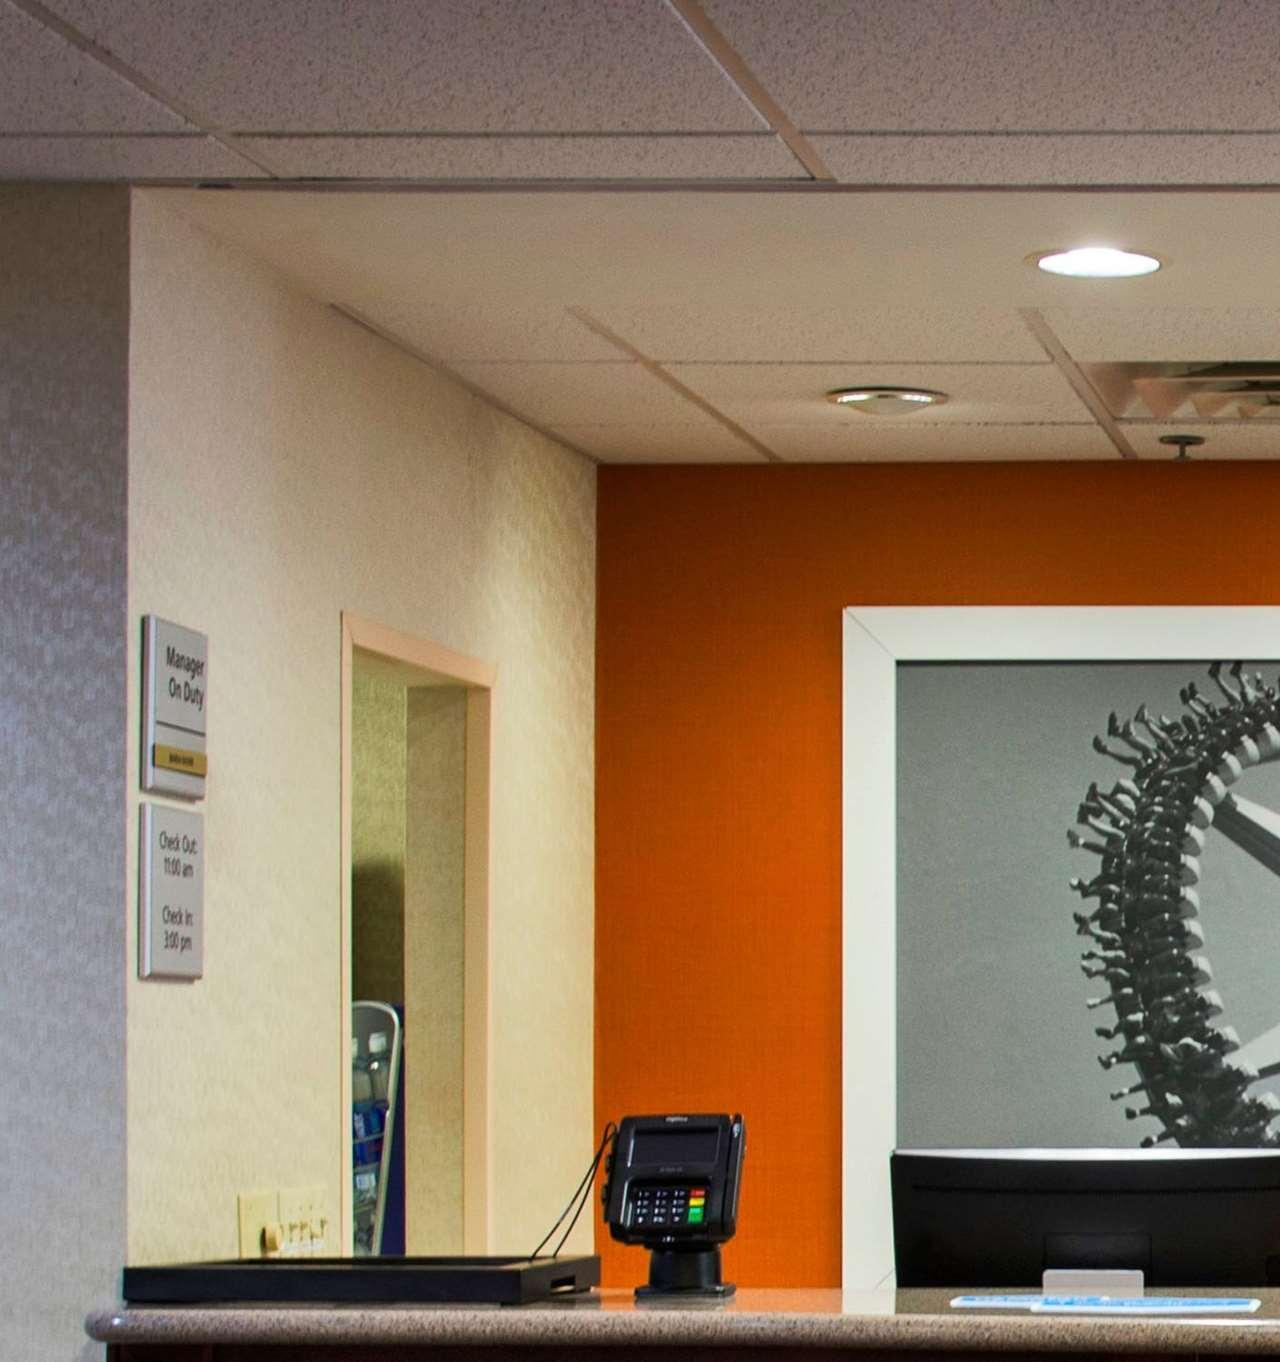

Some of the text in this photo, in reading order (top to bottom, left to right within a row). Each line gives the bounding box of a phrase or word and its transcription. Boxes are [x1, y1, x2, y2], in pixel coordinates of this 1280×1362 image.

[166, 645, 204, 681] Manager
[169, 677, 205, 712] On Duty
[159, 830, 180, 852] Check
[182, 863, 194, 878] am
[162, 905, 183, 925] Check
[180, 935, 193, 955] pm
